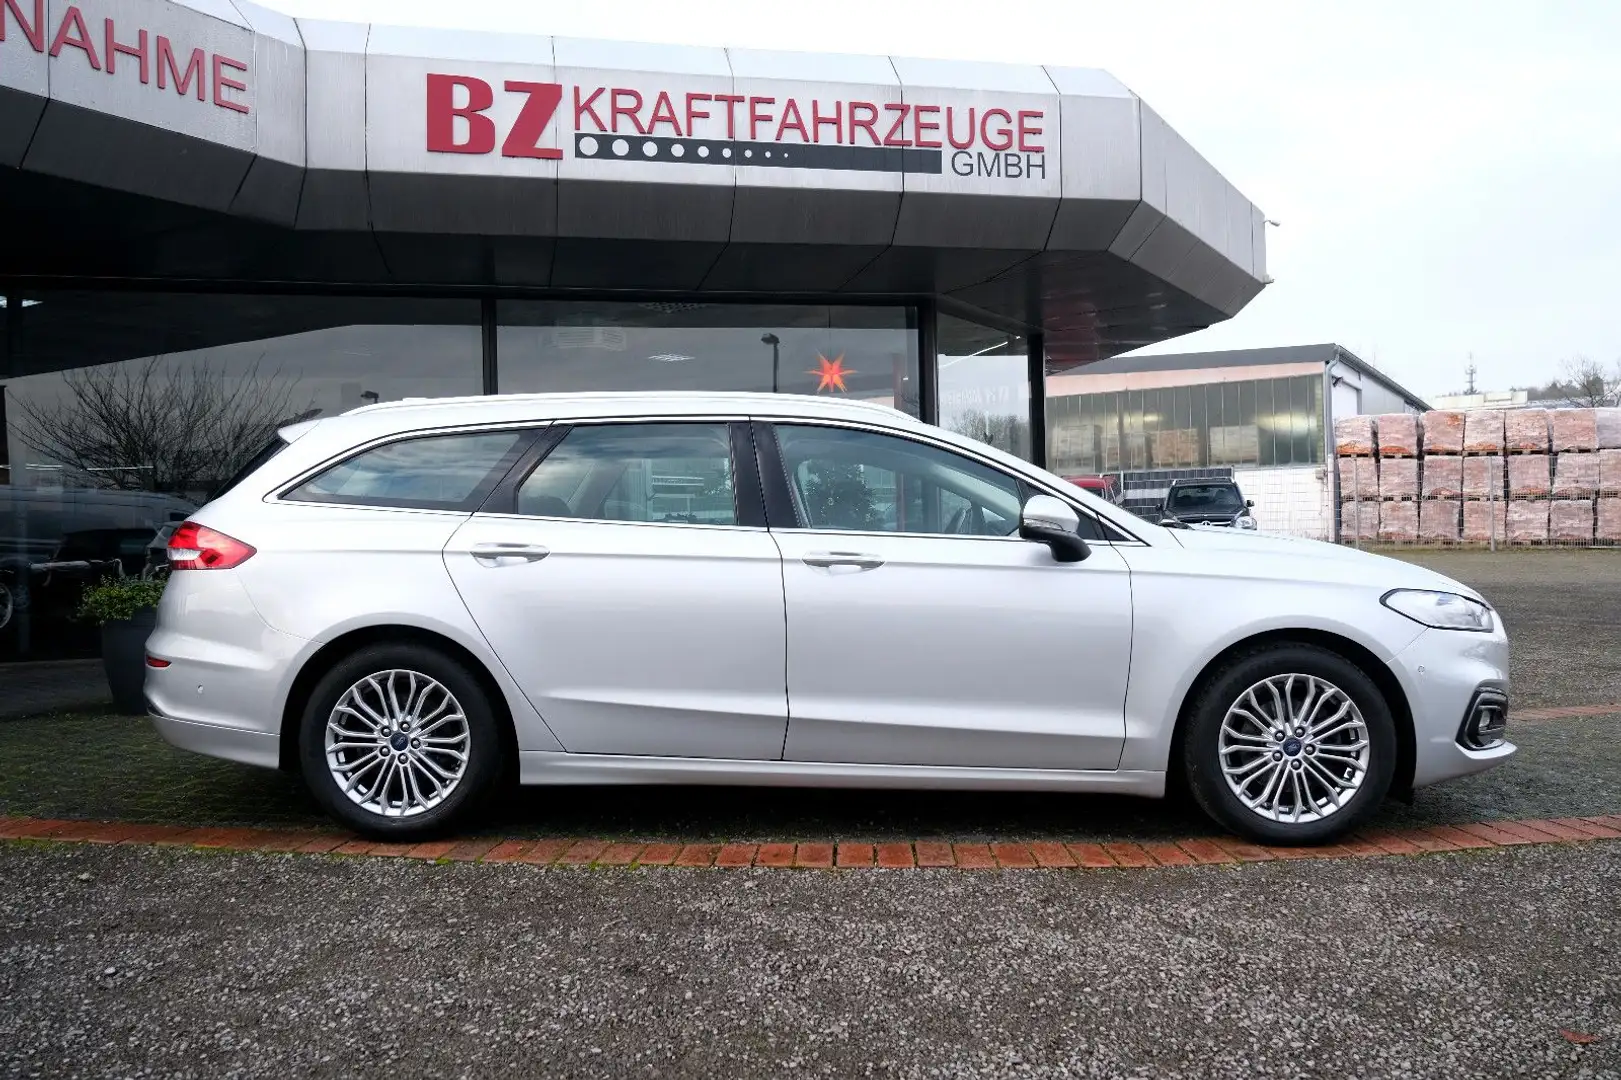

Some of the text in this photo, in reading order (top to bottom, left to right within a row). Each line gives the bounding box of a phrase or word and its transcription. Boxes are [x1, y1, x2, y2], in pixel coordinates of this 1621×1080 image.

[426, 73, 1046, 160] BZ KRAFTFAHRZEUGE
[951, 150, 1046, 180] GMBH
